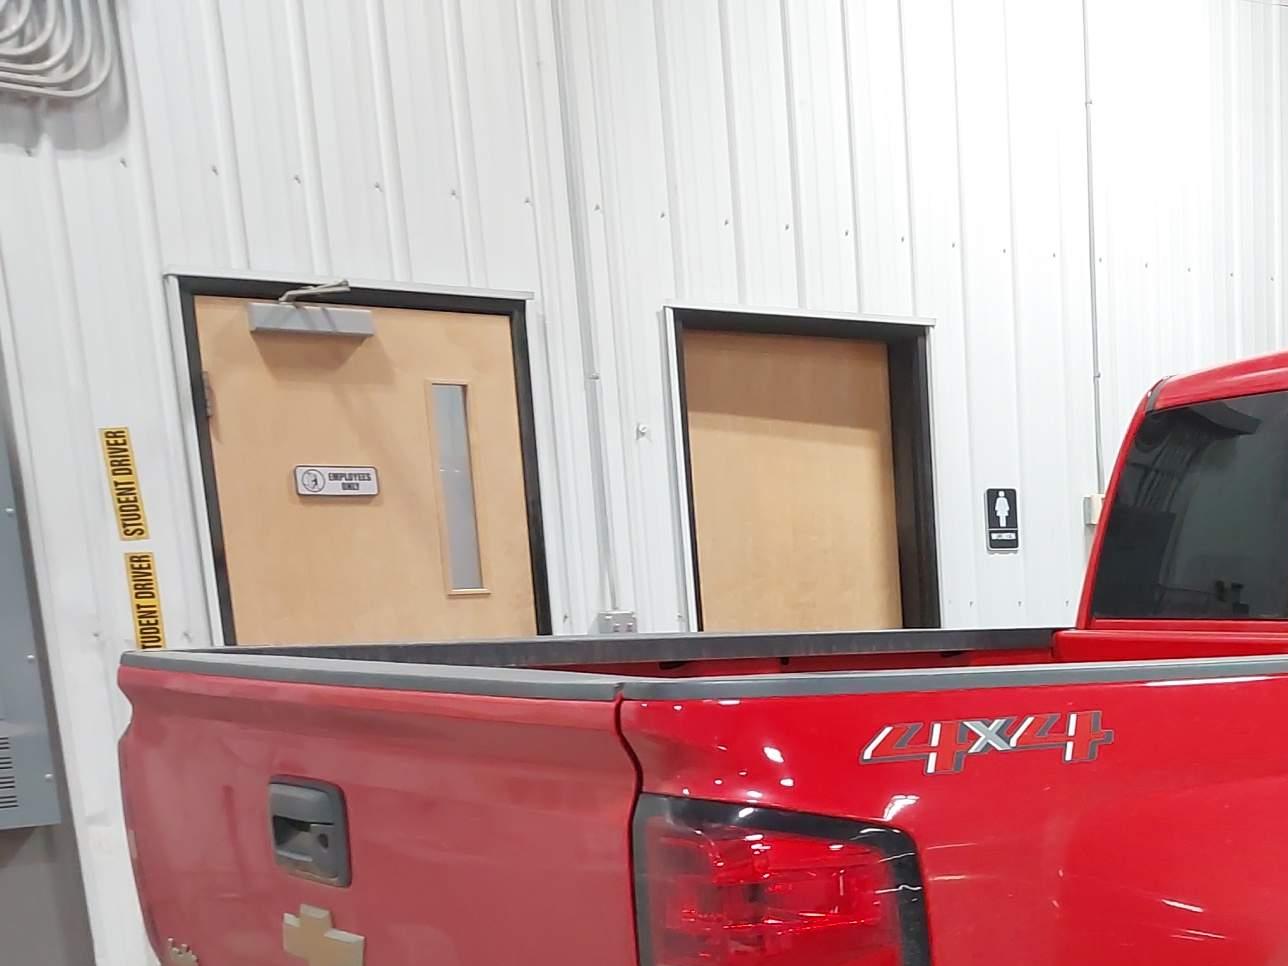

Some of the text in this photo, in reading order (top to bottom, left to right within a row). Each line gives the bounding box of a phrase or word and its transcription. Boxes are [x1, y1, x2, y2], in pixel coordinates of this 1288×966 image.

[105, 430, 146, 537] STUDENT DRIVER
[129, 554, 163, 650] TUDENT DRIVER
